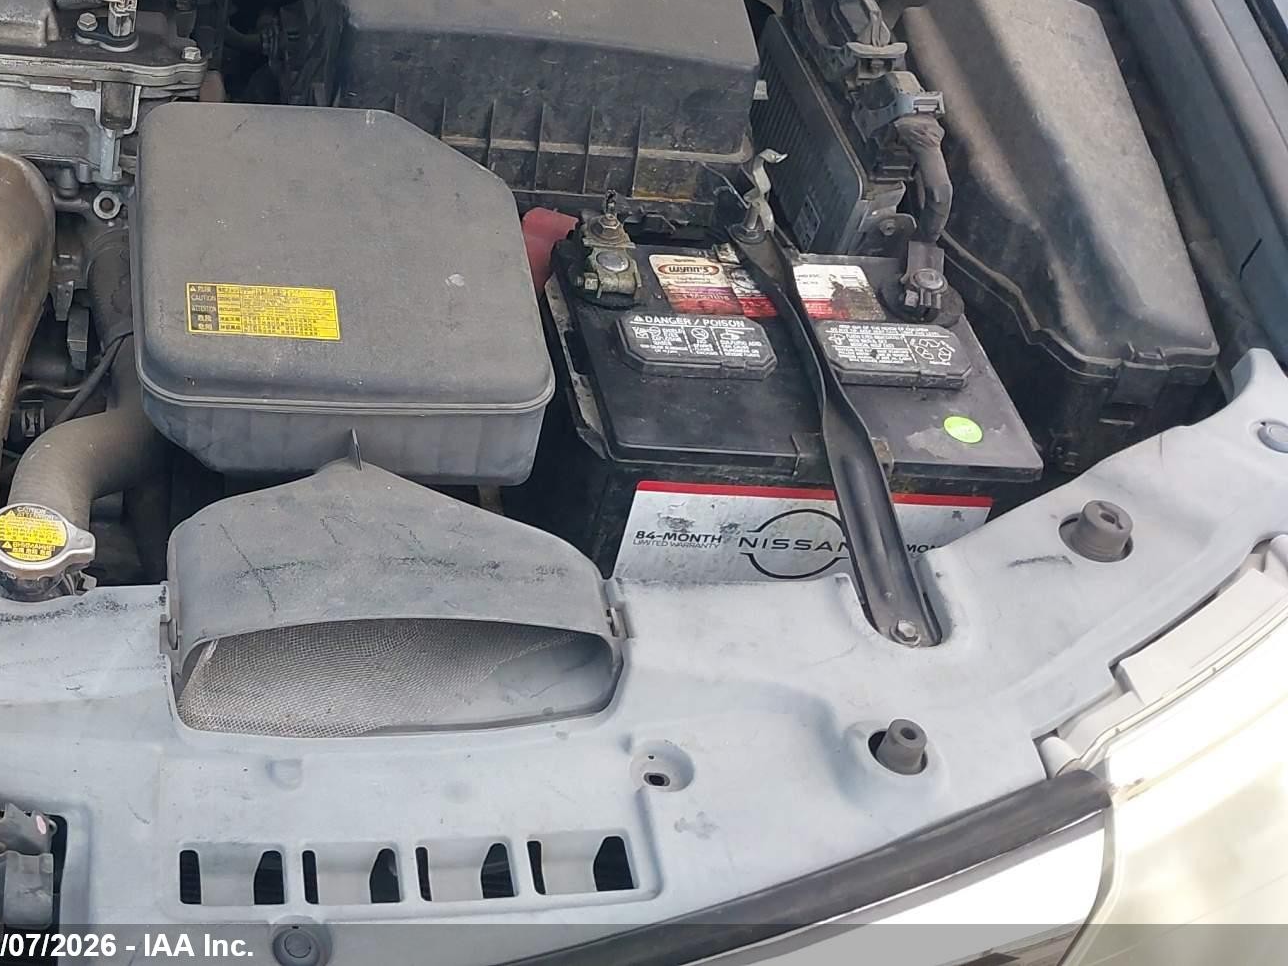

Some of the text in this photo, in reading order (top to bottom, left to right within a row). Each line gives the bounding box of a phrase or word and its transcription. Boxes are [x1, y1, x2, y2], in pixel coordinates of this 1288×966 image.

[644, 316, 692, 326] DANGER
[703, 318, 745, 328] POISON
[635, 530, 723, 543] 84-MONTH
[632, 539, 721, 549] LIMITED WARRANTY
